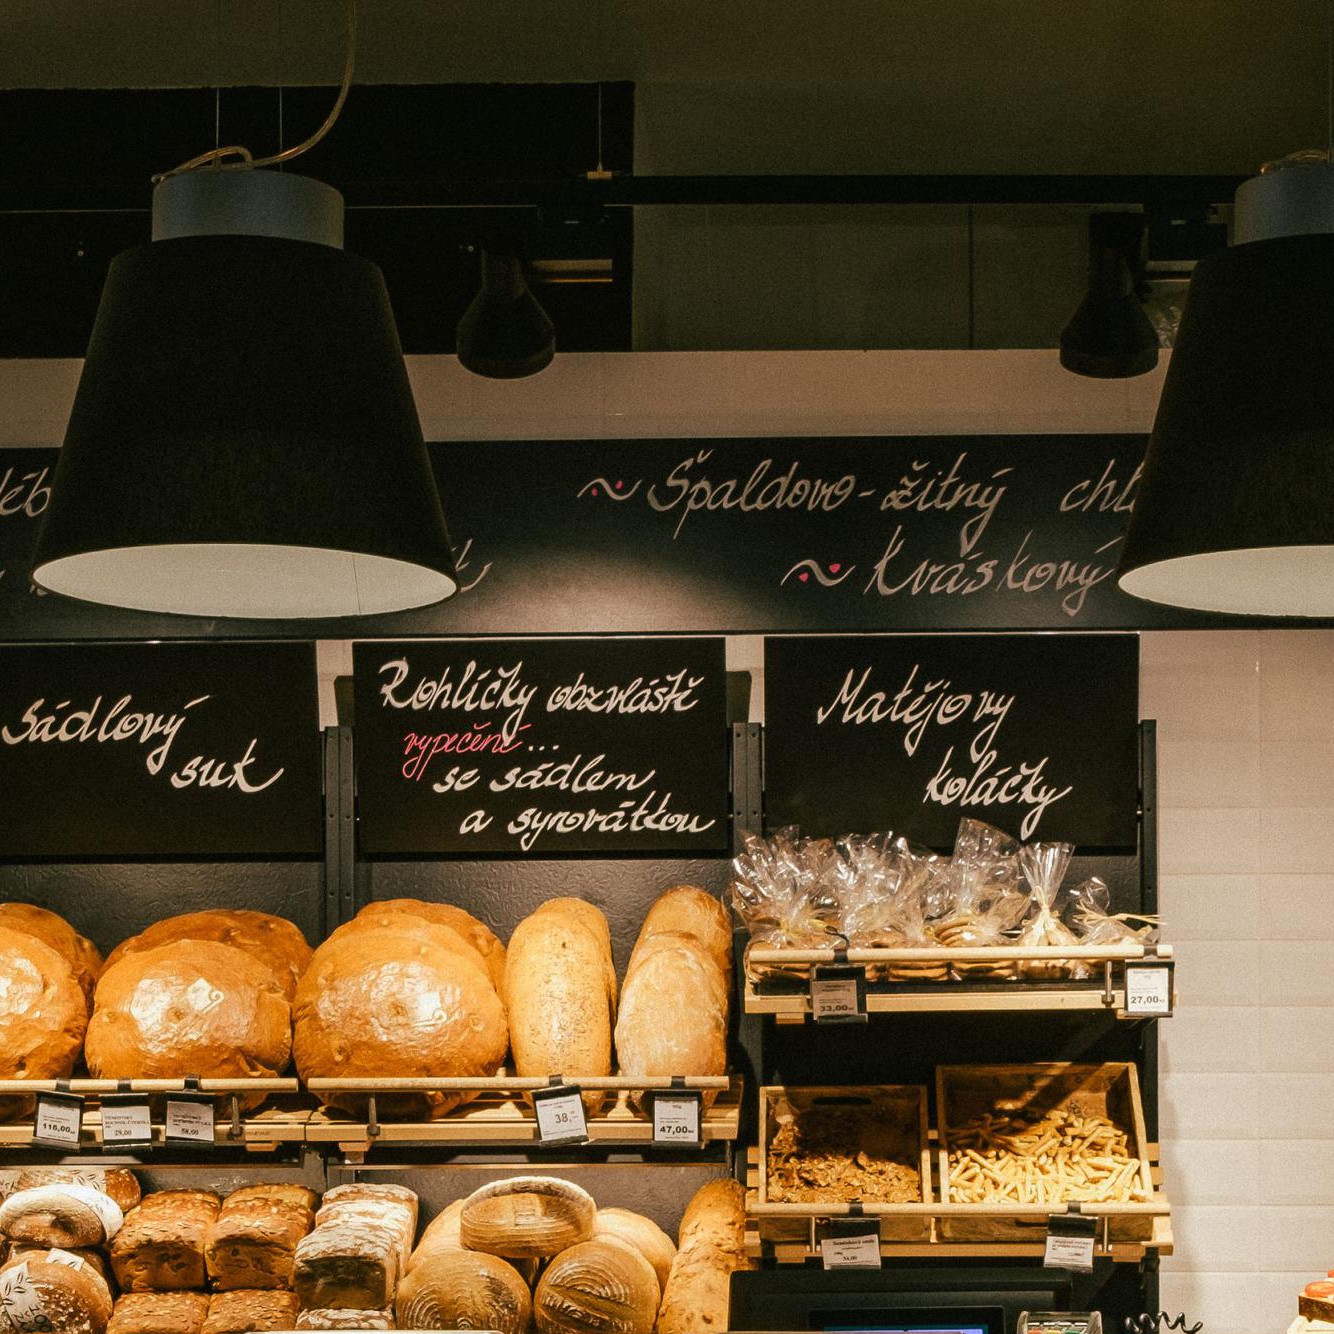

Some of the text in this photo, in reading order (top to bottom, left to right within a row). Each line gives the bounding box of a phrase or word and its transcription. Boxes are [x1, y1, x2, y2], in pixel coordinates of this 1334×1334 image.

[379, 656, 537, 745] Rohlíčky
[170, 738, 284, 792] suk
[433, 754, 655, 793] se sádlem
[459, 809, 493, 835] a
